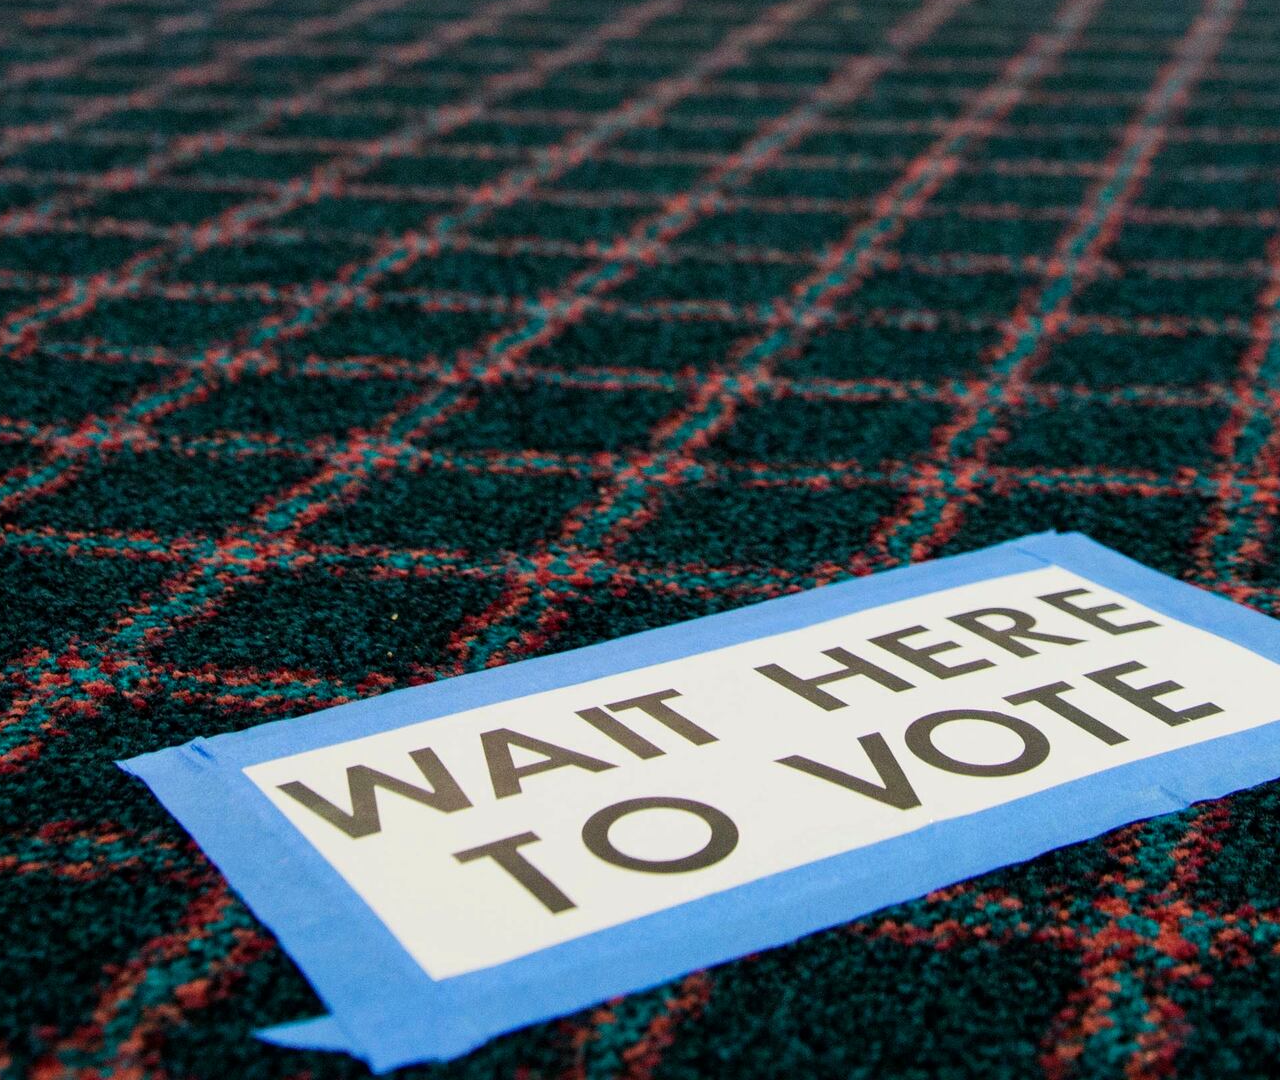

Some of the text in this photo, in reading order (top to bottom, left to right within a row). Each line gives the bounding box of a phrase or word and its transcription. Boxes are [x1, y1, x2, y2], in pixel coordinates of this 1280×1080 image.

[276, 586, 1162, 839] WAIT HERE
[453, 659, 1226, 914] TO VOTE
